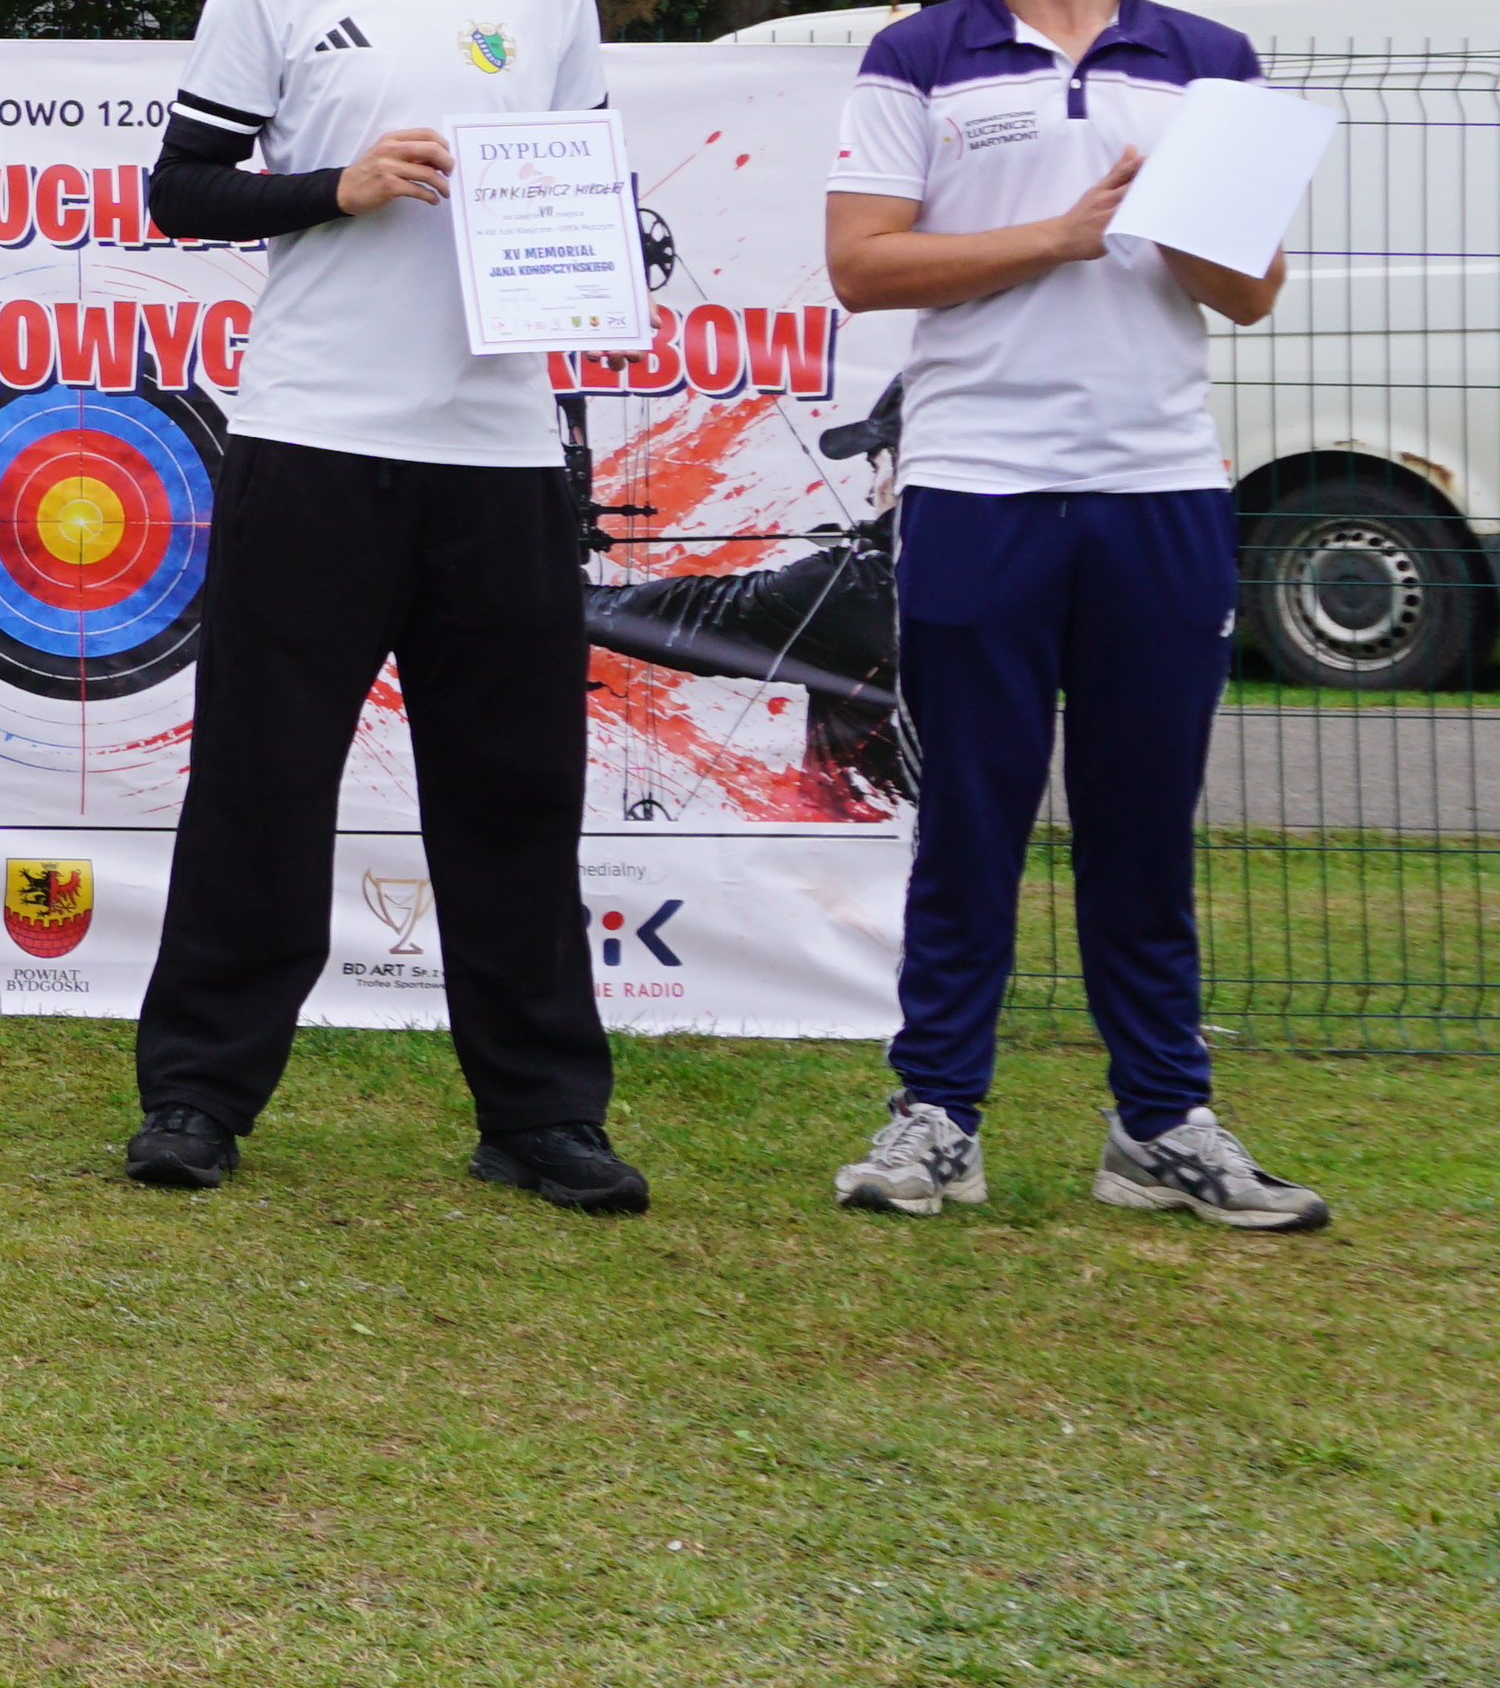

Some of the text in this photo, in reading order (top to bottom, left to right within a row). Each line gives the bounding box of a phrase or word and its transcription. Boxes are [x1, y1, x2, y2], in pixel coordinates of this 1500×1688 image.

[969, 130, 1039, 150] MARYMONT
[479, 140, 592, 161] DYPLOM
[474, 183, 570, 202] STANKIEWICZ
[503, 244, 596, 261] XV MEMORIAŁ
[490, 266, 517, 277] JANA
[13, 968, 82, 981] POWIAT
[343, 963, 366, 975] BD
[370, 964, 405, 976] ART
[6, 980, 90, 993] BYDGOSKI
[356, 979, 391, 988] Trofea
[623, 983, 684, 998] RADIO
